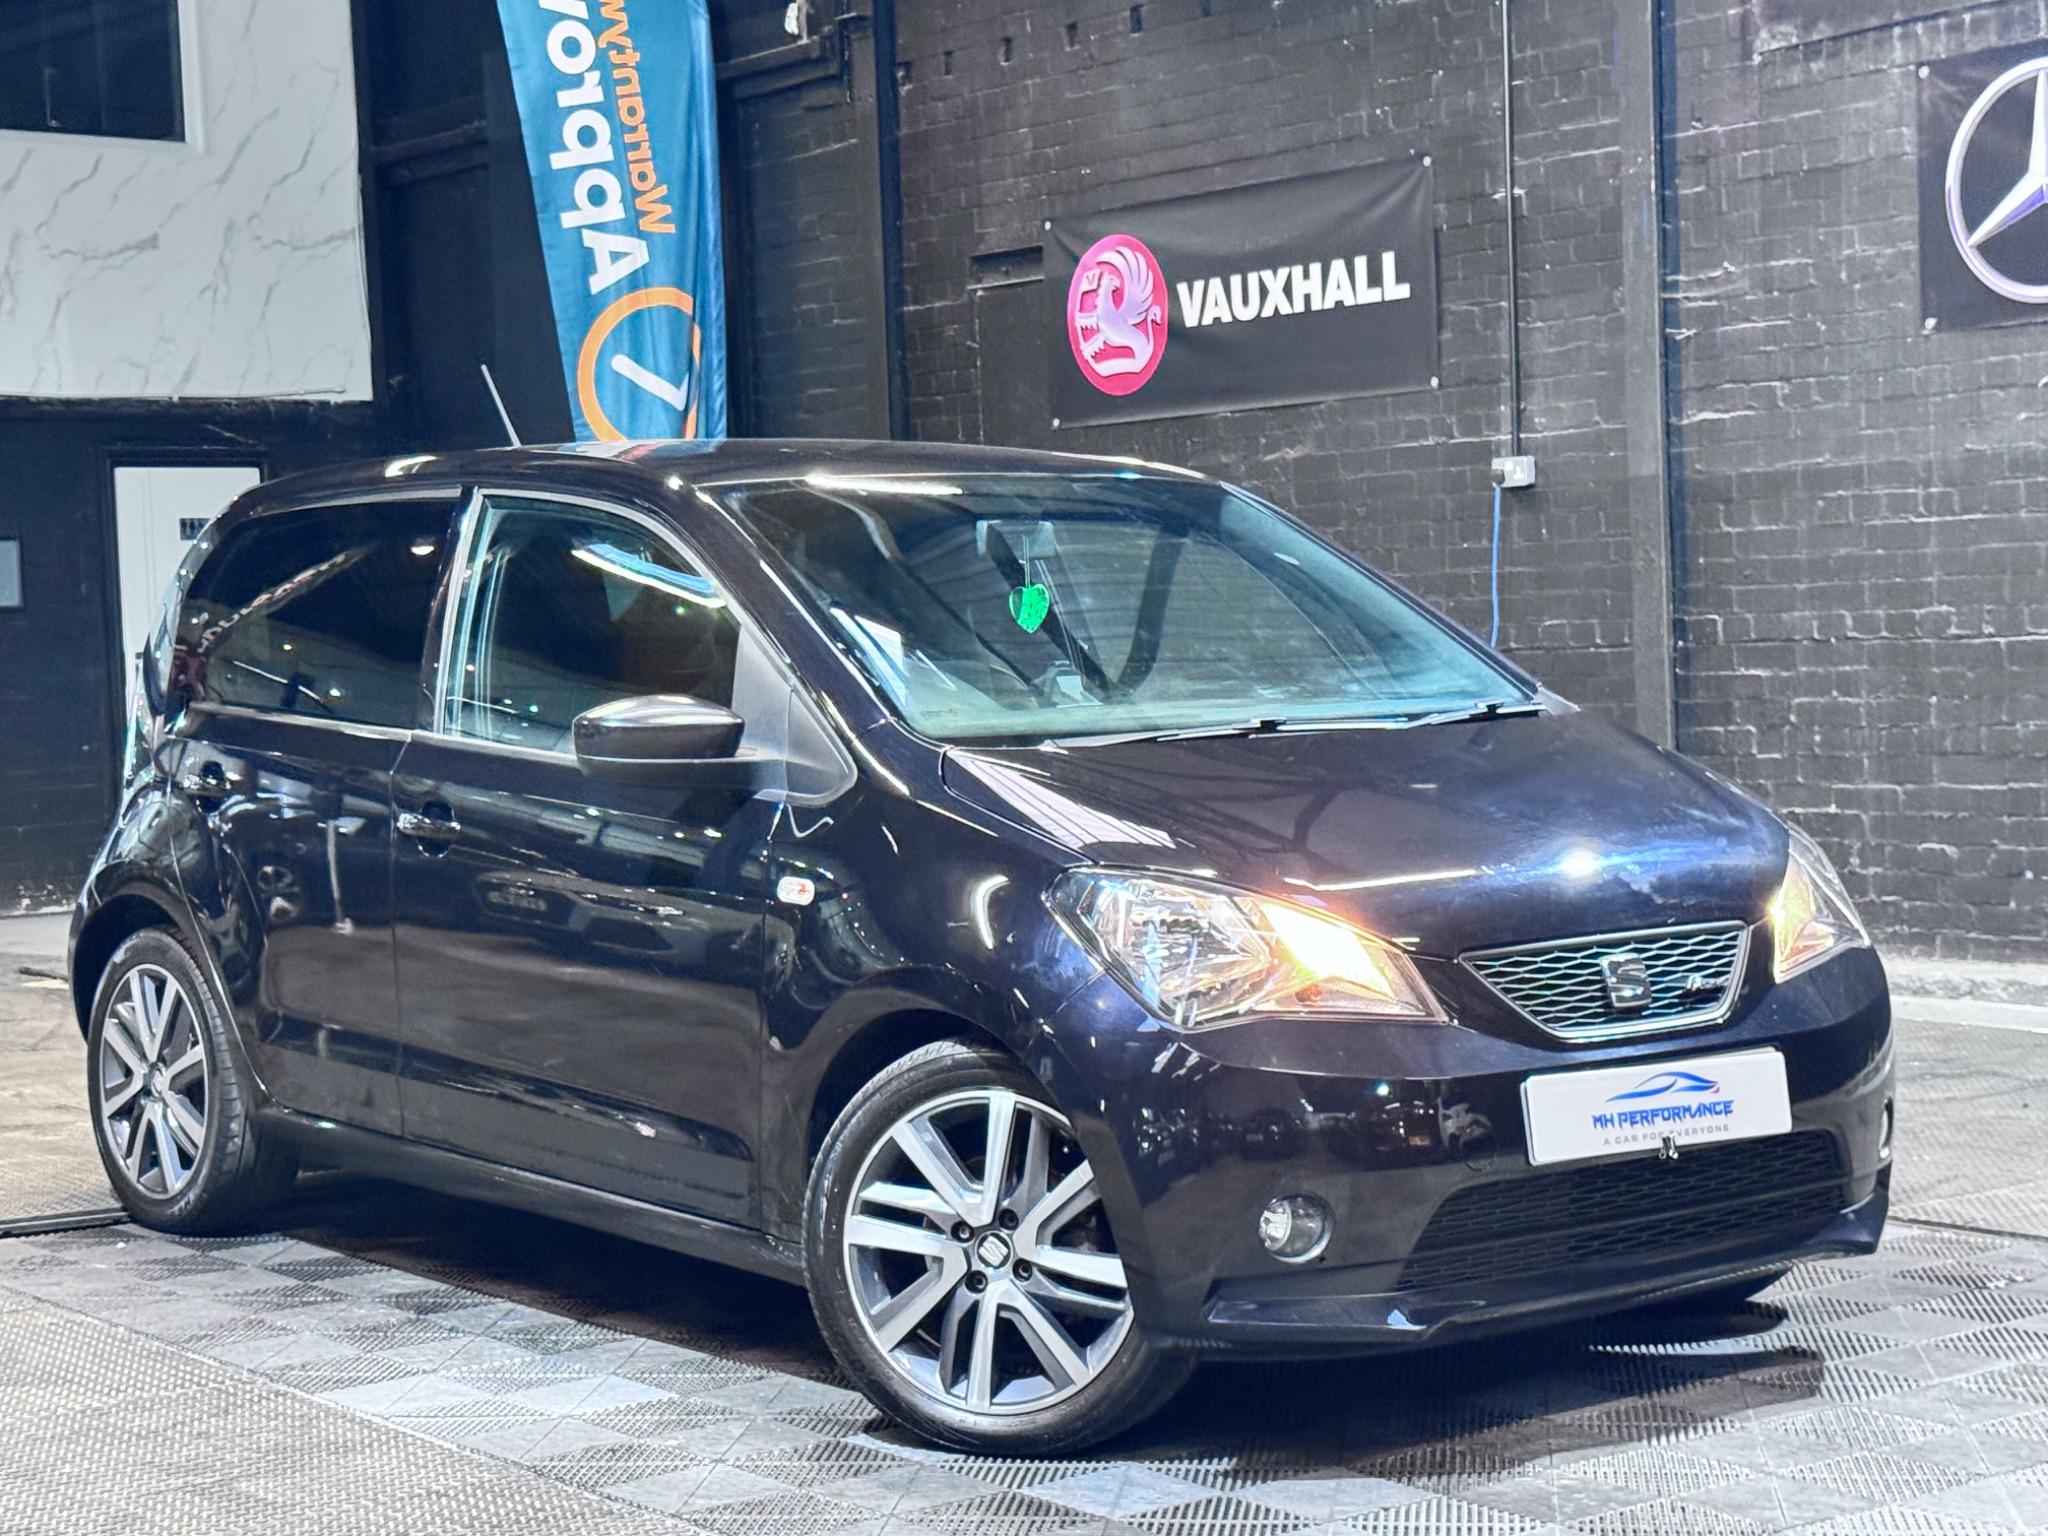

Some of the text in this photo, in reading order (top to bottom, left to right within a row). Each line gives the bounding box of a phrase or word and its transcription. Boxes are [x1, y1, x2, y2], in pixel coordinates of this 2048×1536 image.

[1176, 250, 1412, 328] VAUXHALL
[1591, 1099, 1735, 1130] MH PERFORMANCE
[1602, 1137, 1611, 1146] A
[1614, 1134, 1639, 1145] CAR
